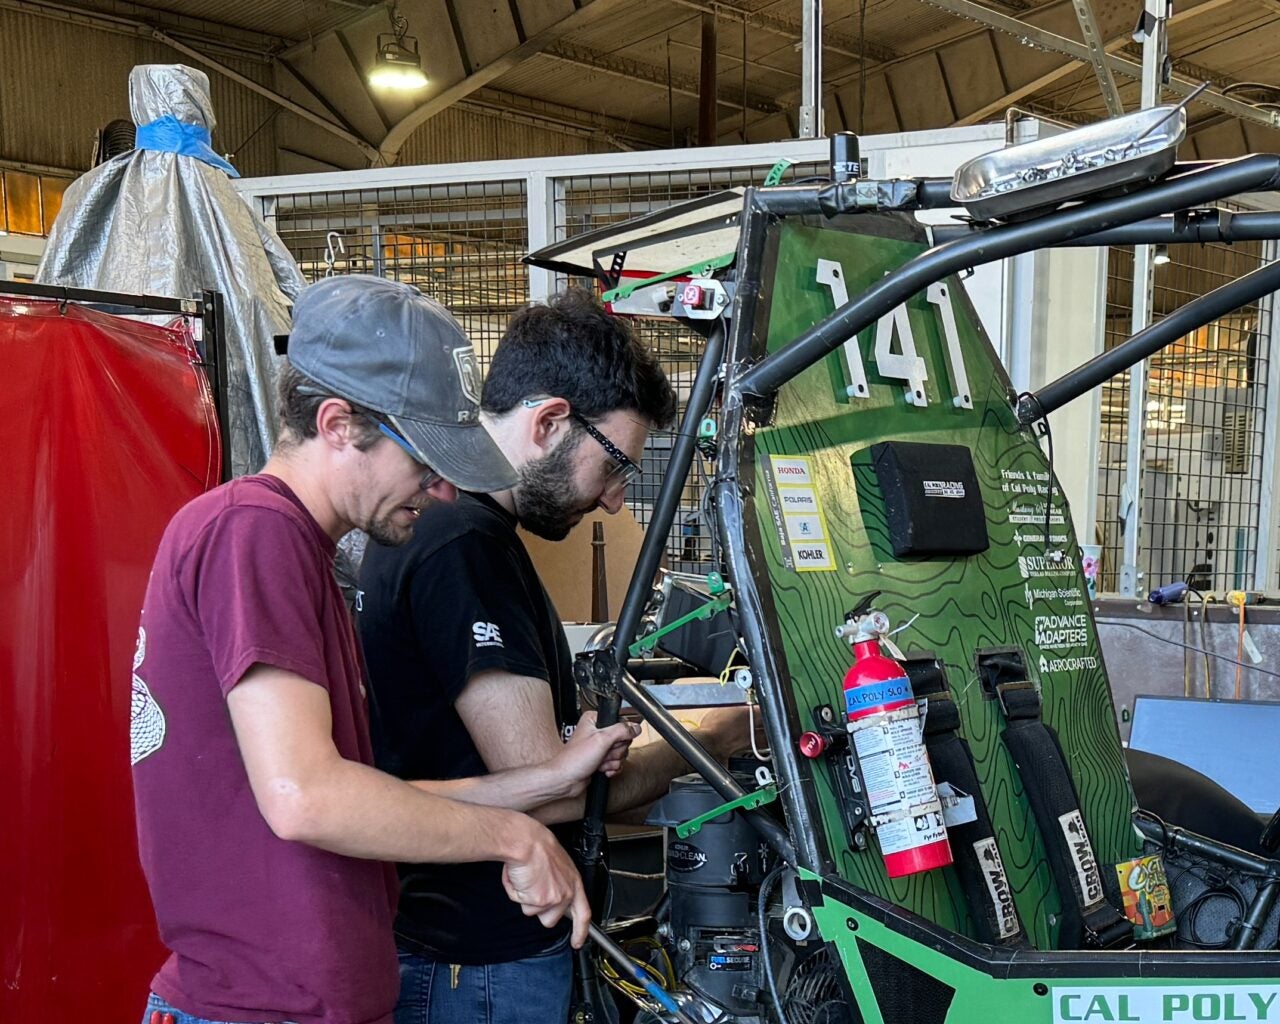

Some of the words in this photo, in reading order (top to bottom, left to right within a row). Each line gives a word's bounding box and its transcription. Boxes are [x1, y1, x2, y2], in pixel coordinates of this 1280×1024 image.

[816, 258, 973, 409] 141
[778, 467, 805, 475] HONDA
[1037, 485, 1059, 496] Racng
[784, 496, 813, 504] POLARIS
[797, 550, 824, 559] KOHLER
[1026, 556, 1075, 570] SUPERIOR
[1033, 589, 1058, 600] Michigan
[1058, 588, 1081, 598] Scientific
[1043, 615, 1086, 628] ADVANCE
[1039, 629, 1087, 643] ADAPTERS
[1049, 657, 1096, 672] AEROCRAFTED
[862, 691, 884, 701] POLY
[1073, 841, 1098, 901] CROW
[989, 870, 1014, 933] CROW
[1060, 994, 1141, 1021] CAL
[1162, 992, 1277, 1022] POLY
